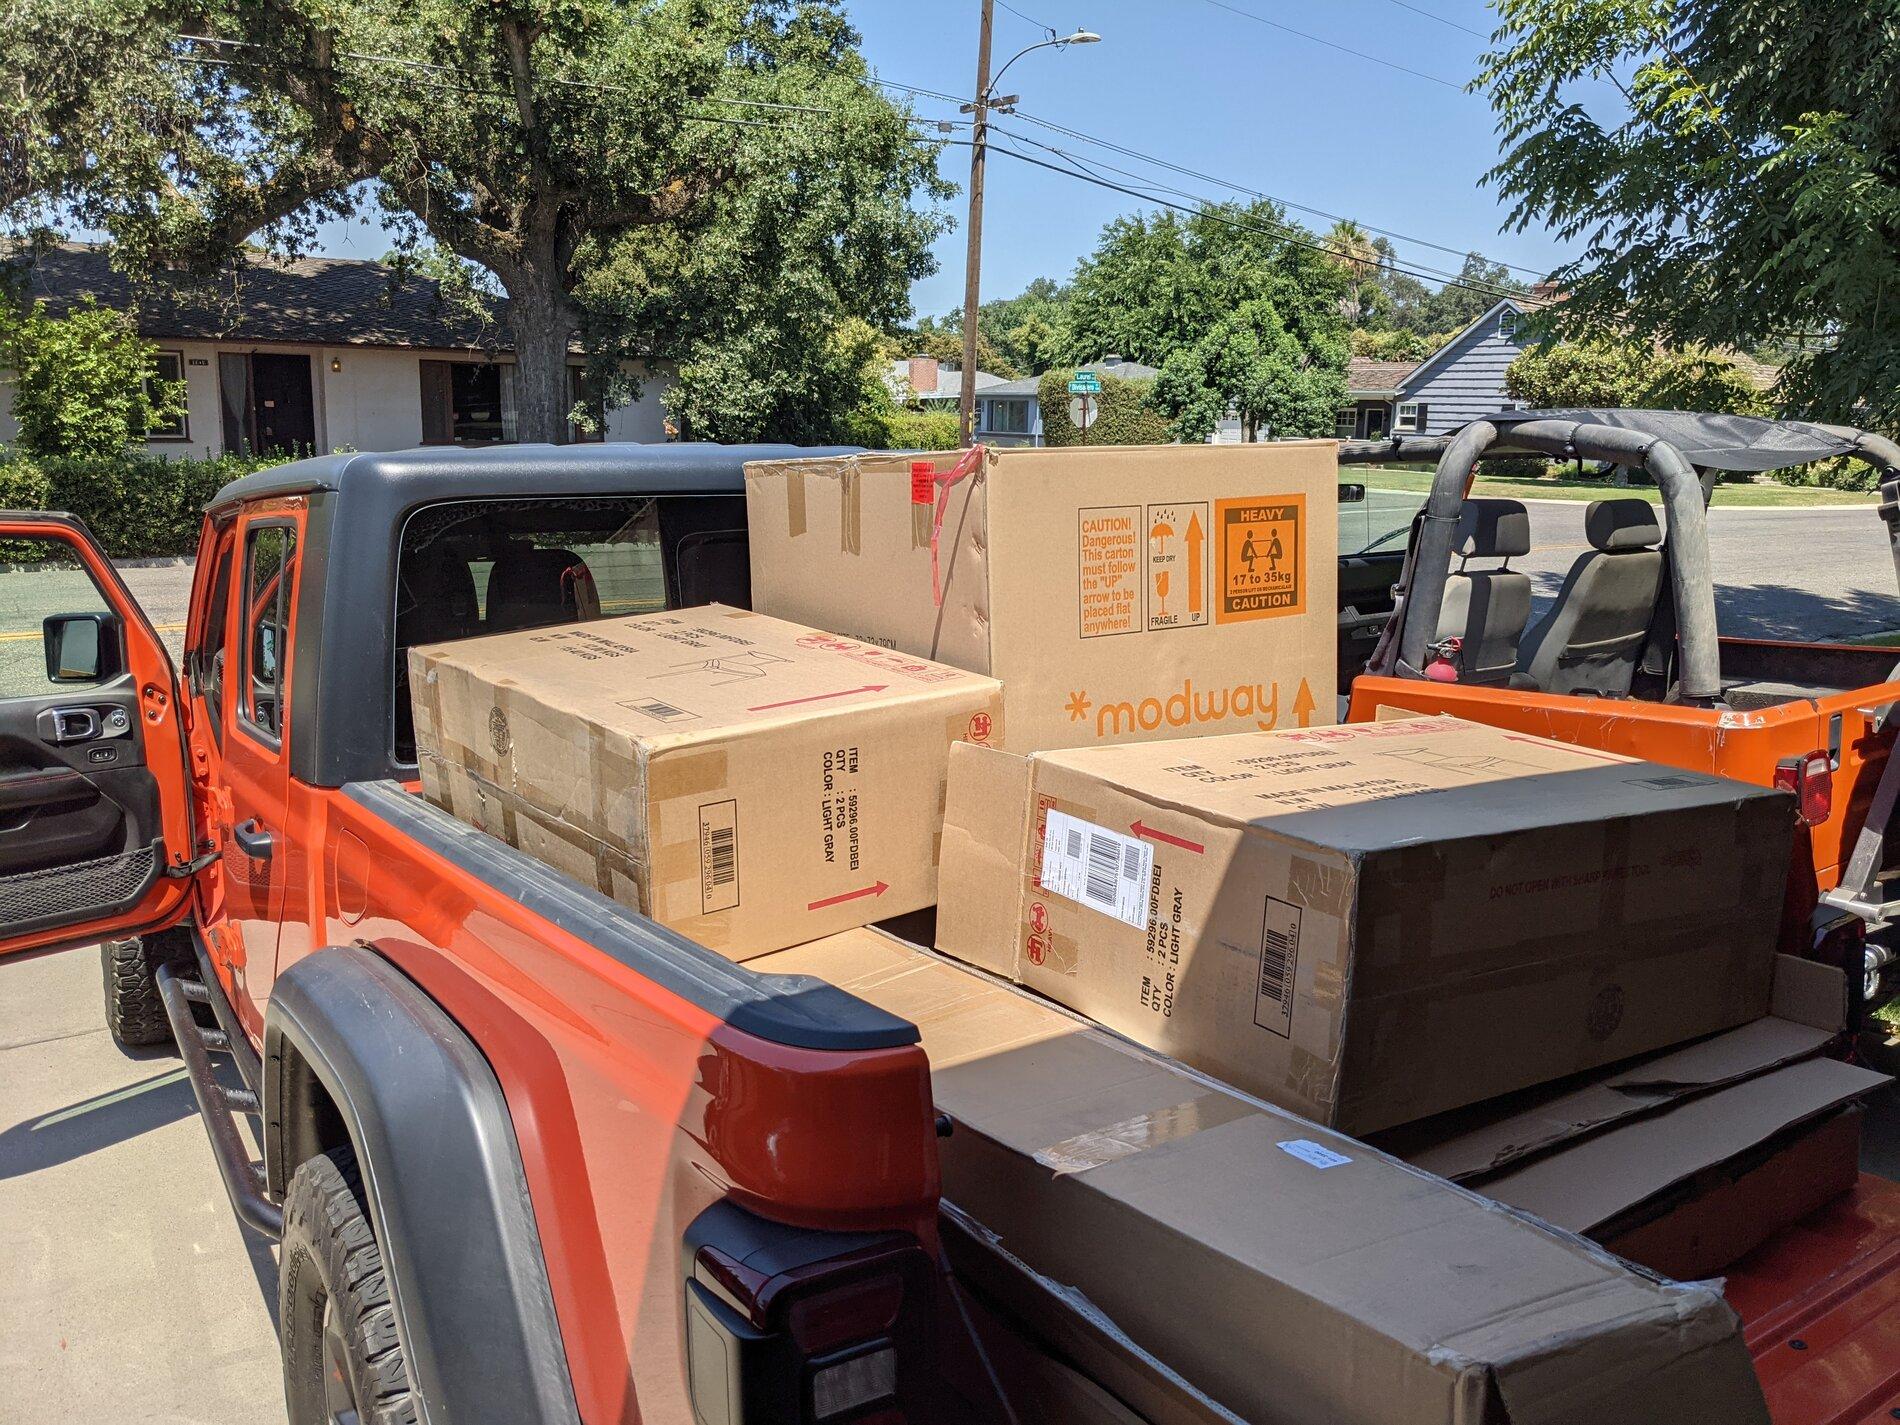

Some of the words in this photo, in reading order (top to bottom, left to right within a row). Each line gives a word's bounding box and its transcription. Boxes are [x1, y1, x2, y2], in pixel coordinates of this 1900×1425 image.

[1240, 508, 1284, 521] HEAVY
[1082, 517, 1131, 533] CAUTION!
[1082, 532, 1136, 549] Dangerous!
[1083, 549, 1102, 561] This
[1105, 547, 1133, 560] carton
[1153, 556, 1166, 564] KEEP
[1166, 554, 1176, 562] DRY
[1083, 564, 1107, 576] must
[1108, 561, 1136, 574] follow
[1233, 574, 1246, 585] 17
[1250, 574, 1261, 584] to
[1264, 571, 1291, 584] 35kg
[1083, 578, 1098, 590] the
[1100, 574, 1122, 588] "UP"
[1083, 592, 1110, 604] arrow
[1112, 590, 1121, 601] to
[1123, 588, 1134, 600] be
[1232, 593, 1291, 610] CAUTION
[1084, 605, 1114, 621] placed
[1116, 602, 1131, 615] flat
[1150, 614, 1178, 626] FRAGILE
[1192, 613, 1200, 622] UP
[1084, 616, 1131, 634] anywhere!
[1097, 679, 1278, 737] modway
[836, 750, 846, 772] QTY
[849, 747, 858, 773] ITEM
[823, 752, 833, 791] COLOR
[836, 797, 845, 805] 2
[821, 800, 833, 831] LIGHT
[836, 807, 846, 829] PCS
[848, 795, 859, 871] 59296.00FDBEI
[824, 834, 834, 863] GRAY
[1173, 887, 1183, 923] GRAY
[1140, 976, 1151, 1007] ITEM
[1146, 865, 1162, 955] 59296.00FDBEI
[1158, 922, 1169, 949] PCS
[1169, 926, 1181, 965] LIGHT
[1157, 952, 1166, 961] 2
[1152, 985, 1162, 1012] QTY
[1162, 972, 1175, 1018] COLOR
